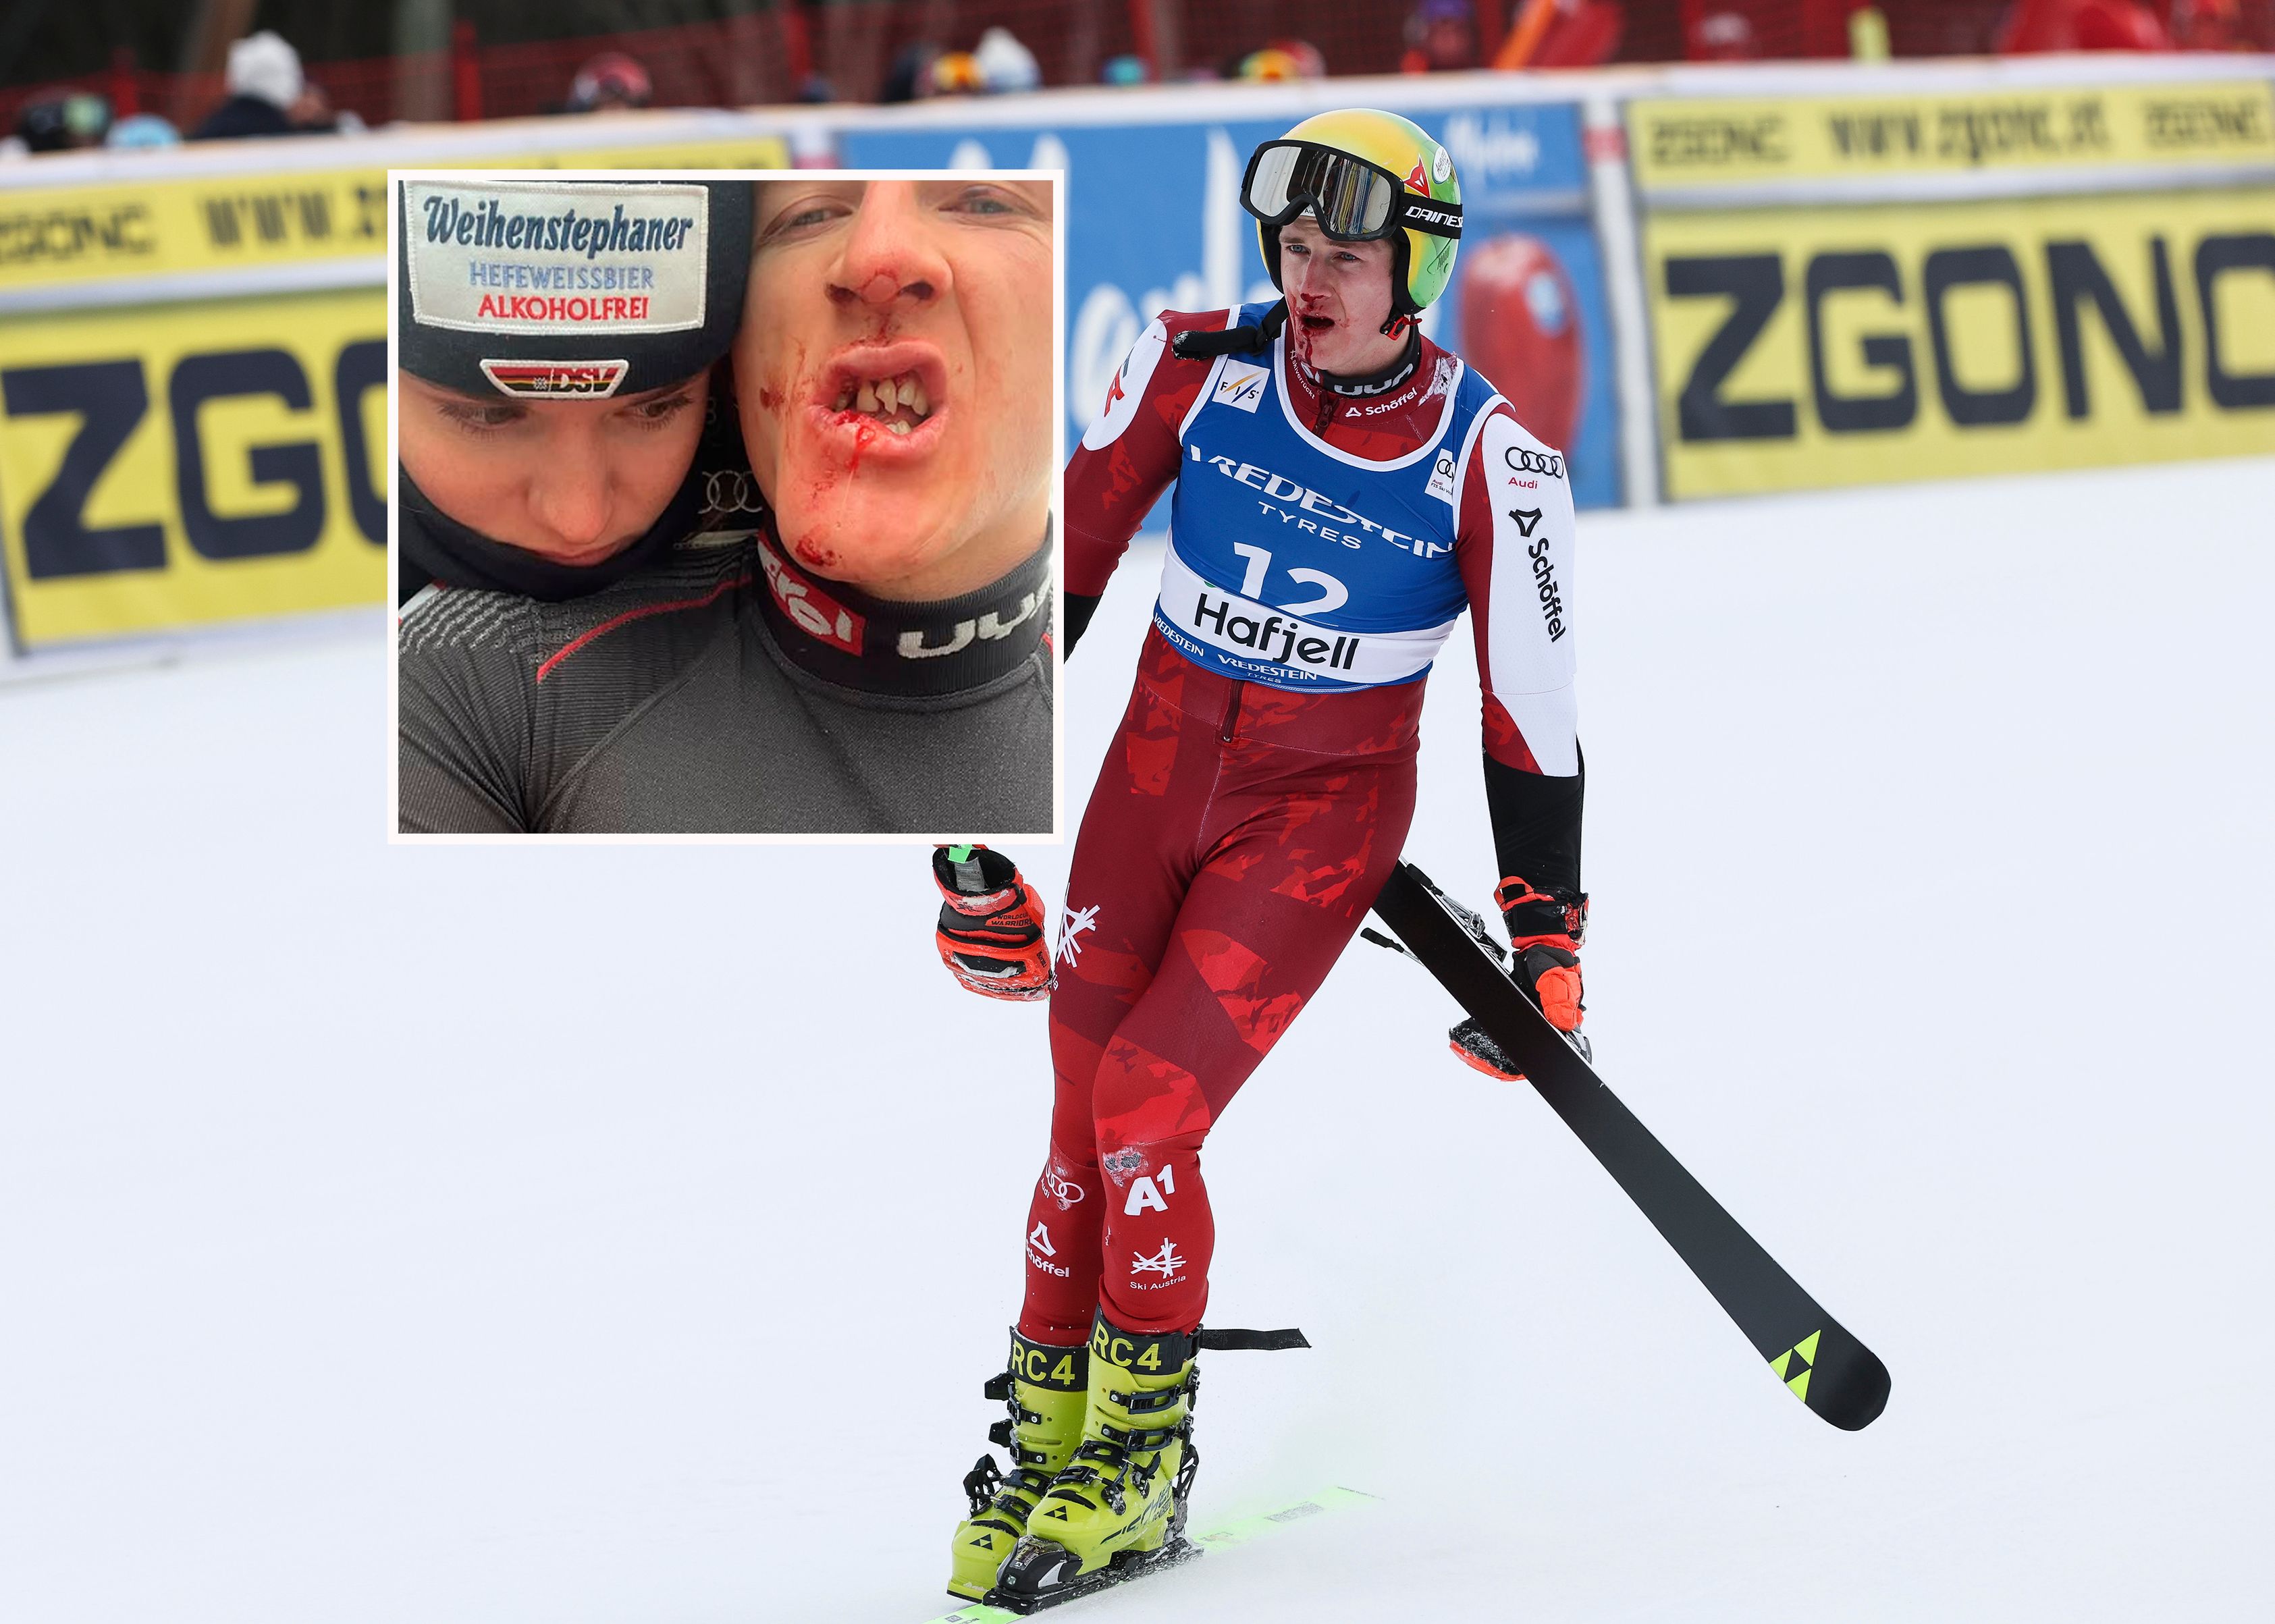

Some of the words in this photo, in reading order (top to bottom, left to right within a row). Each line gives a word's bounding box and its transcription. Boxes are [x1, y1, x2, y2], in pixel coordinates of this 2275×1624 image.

[424, 196, 693, 259] Weihenstephaner
[470, 261, 653, 290] HEFEWEISSBIER
[478, 294, 649, 320] ALKOHOLFREI
[1665, 229, 2275, 442] ZGONC
[551, 367, 618, 393] DSV
[1508, 477, 1538, 489] Audi
[1258, 501, 1361, 549] TYRES
[1233, 541, 1349, 618] 12
[1154, 612, 1204, 657] VREDESTEIN
[1194, 593, 1360, 670] Hafjell
[1217, 654, 1316, 680] VREDESTEIN
[1247, 673, 1283, 684] TYRES
[1123, 1164, 1175, 1216] A1
[1129, 1281, 1147, 1291] Ski
[1150, 1275, 1186, 1290] Austria
[1011, 1338, 1075, 1385] RC4
[1093, 1320, 1162, 1371] RC4
